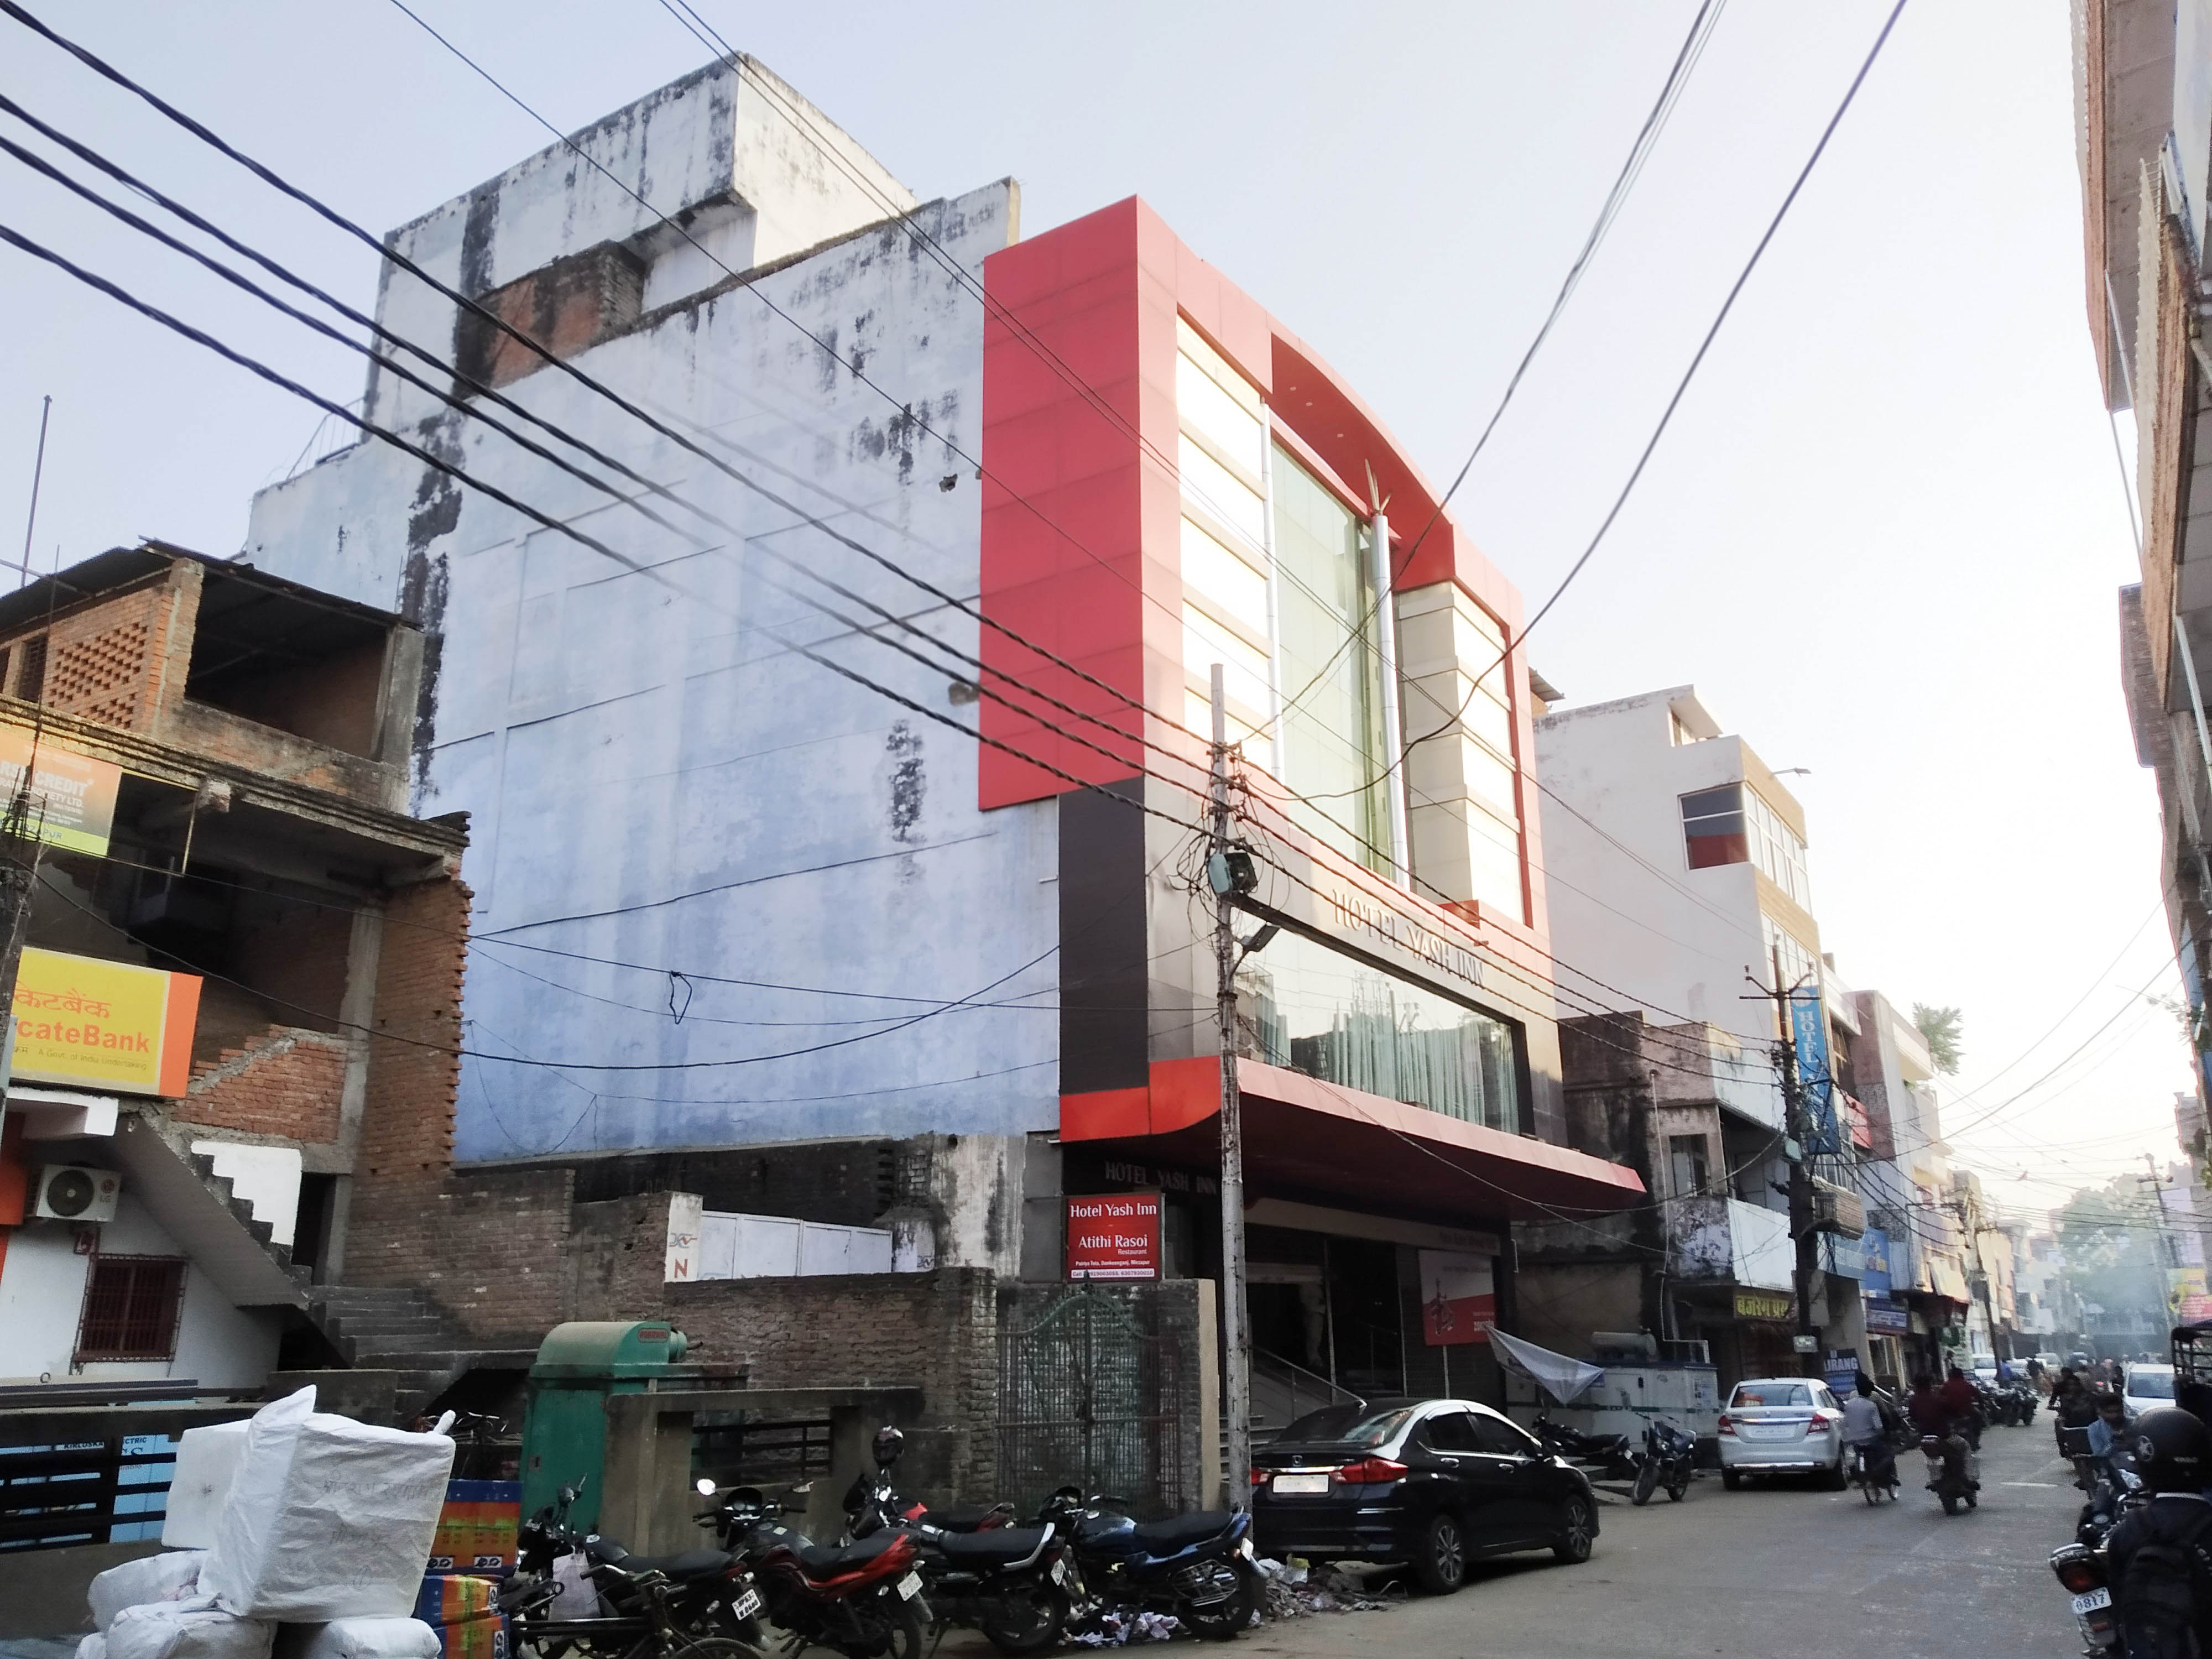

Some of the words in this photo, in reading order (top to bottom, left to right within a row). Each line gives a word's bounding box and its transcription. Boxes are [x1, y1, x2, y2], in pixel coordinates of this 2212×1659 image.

[35, 769, 88, 797] CREDIT
[1332, 888, 1403, 952] HOTEL
[1406, 925, 1452, 977] YASH
[1456, 950, 1485, 987] INN
[14, 980, 112, 1019] केटबैंक
[17, 1020, 150, 1053] cateBank
[1798, 1010, 1819, 1063] HOTEL
[80, 1055, 99, 1064] India
[101, 1057, 147, 1071] Undertaking
[1105, 1161, 1149, 1186] HOTEL
[1071, 1204, 1102, 1218] Hotel
[1105, 1203, 1134, 1216] Yash
[1137, 1202, 1157, 1215] Inn
[1078, 1234, 1112, 1249] Atithi
[1115, 1234, 1148, 1248] Rasoi
[1824, 1357, 1859, 1372] JRANG
